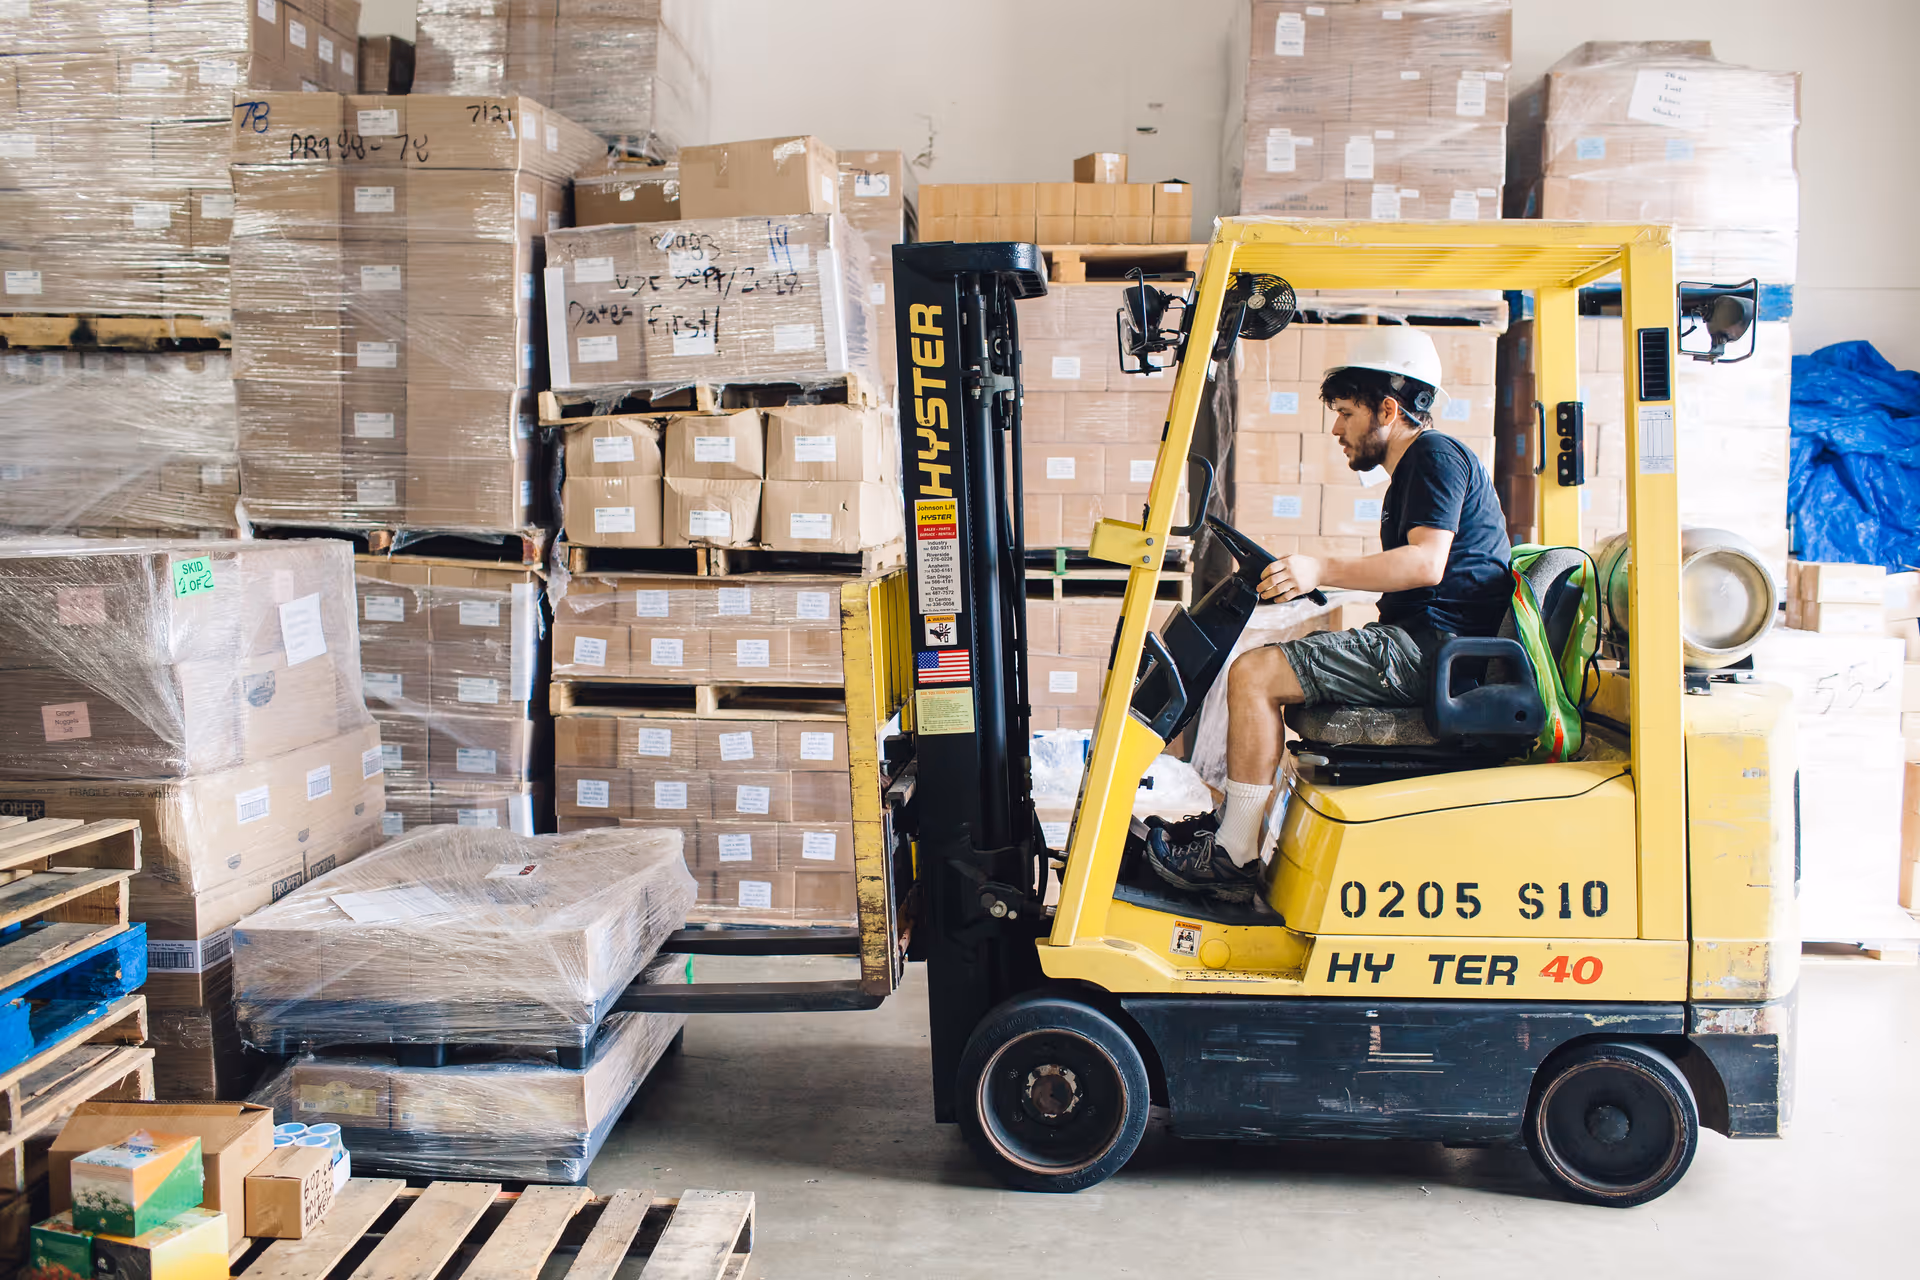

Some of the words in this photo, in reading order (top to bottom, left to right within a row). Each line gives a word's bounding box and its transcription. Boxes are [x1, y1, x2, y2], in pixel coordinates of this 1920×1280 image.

[235, 101, 270, 133] 78
[909, 303, 953, 497] HYSTER
[182, 561, 203, 574] SKID
[190, 579, 201, 591] OF
[199, 570, 214, 588] 2
[1340, 880, 1482, 919] 0205
[1518, 880, 1609, 920] S10
[1538, 955, 1604, 985] 40
